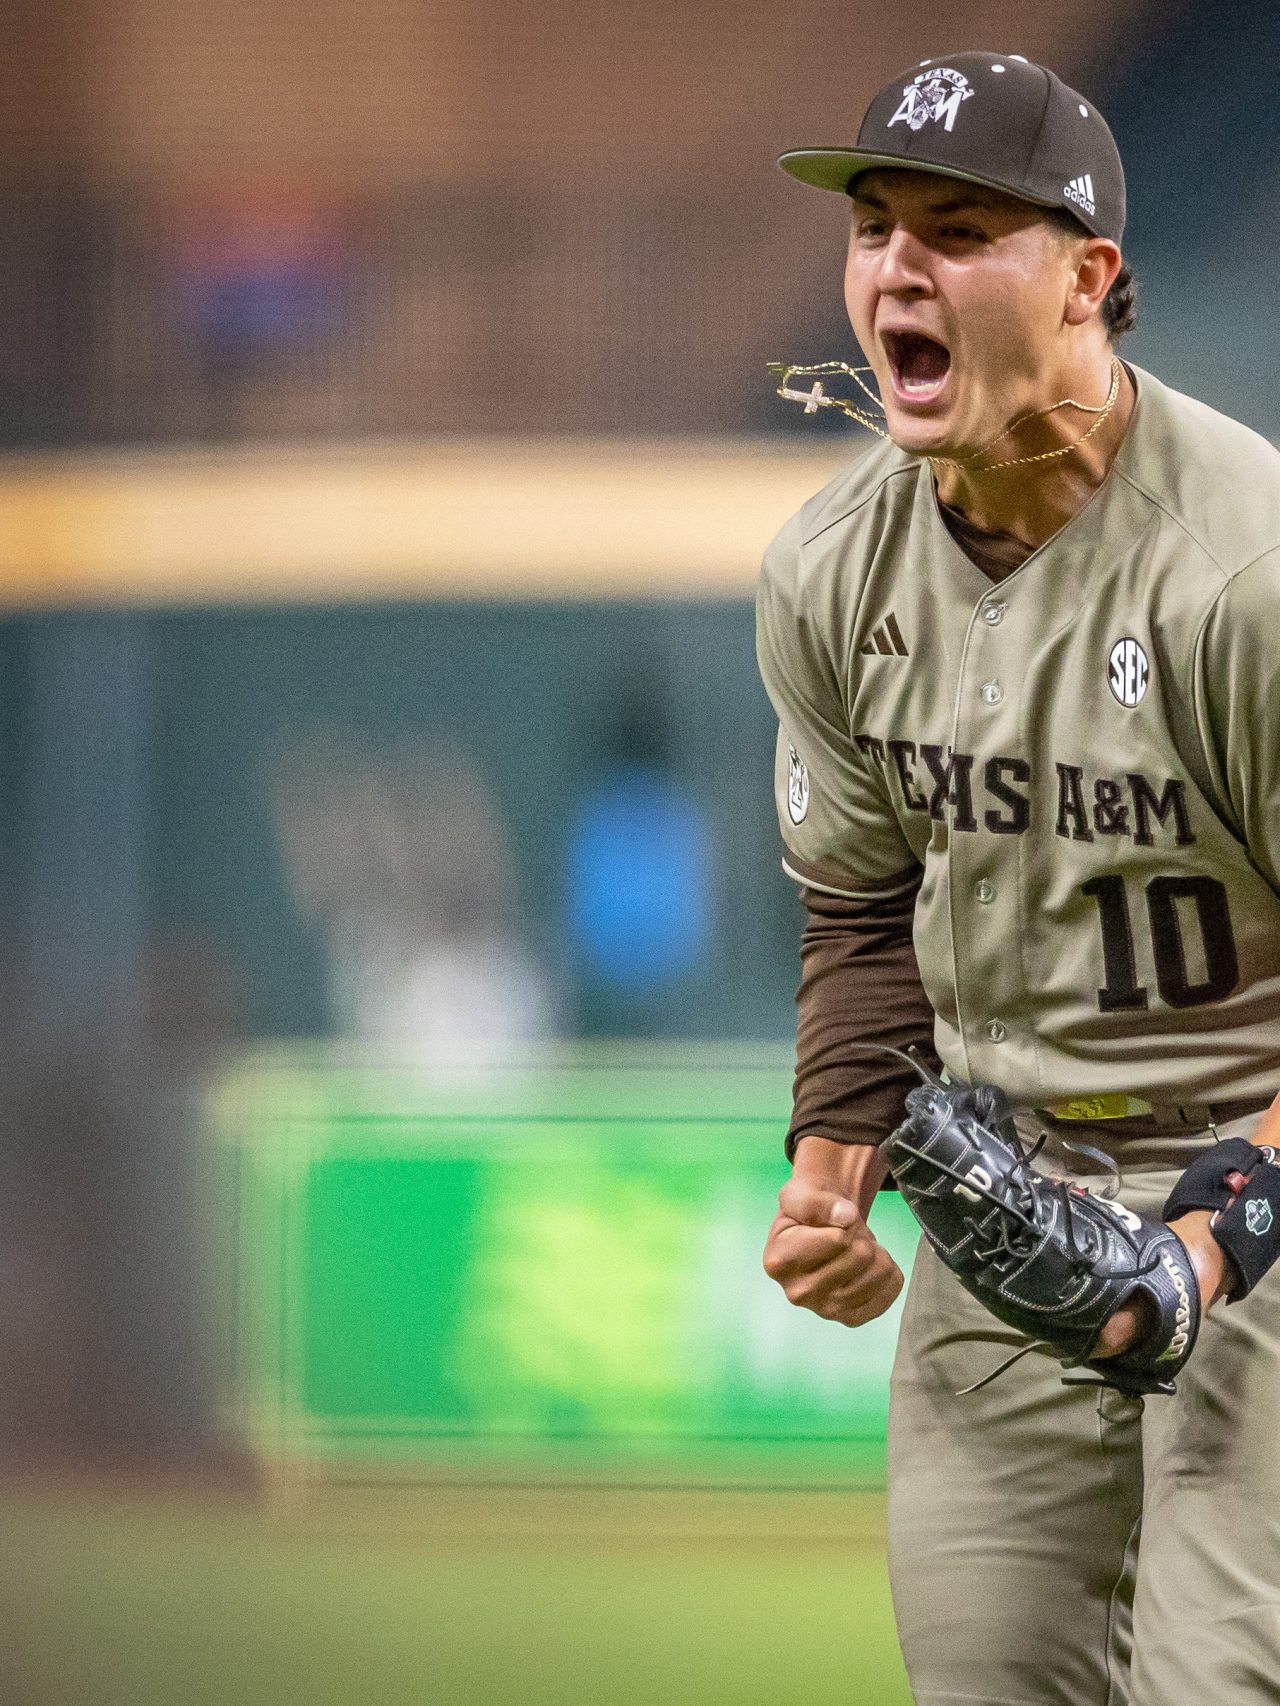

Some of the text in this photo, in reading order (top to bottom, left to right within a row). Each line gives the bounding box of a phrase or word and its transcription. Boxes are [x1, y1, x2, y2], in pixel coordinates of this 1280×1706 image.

[918, 67, 966, 86] TEXAS
[1063, 186, 1096, 216] adidas
[1109, 639, 1148, 705] SEC
[1055, 762, 1196, 846] A&M
[1082, 875, 1239, 1012] 10
[1160, 1254, 1191, 1360] Wilson
